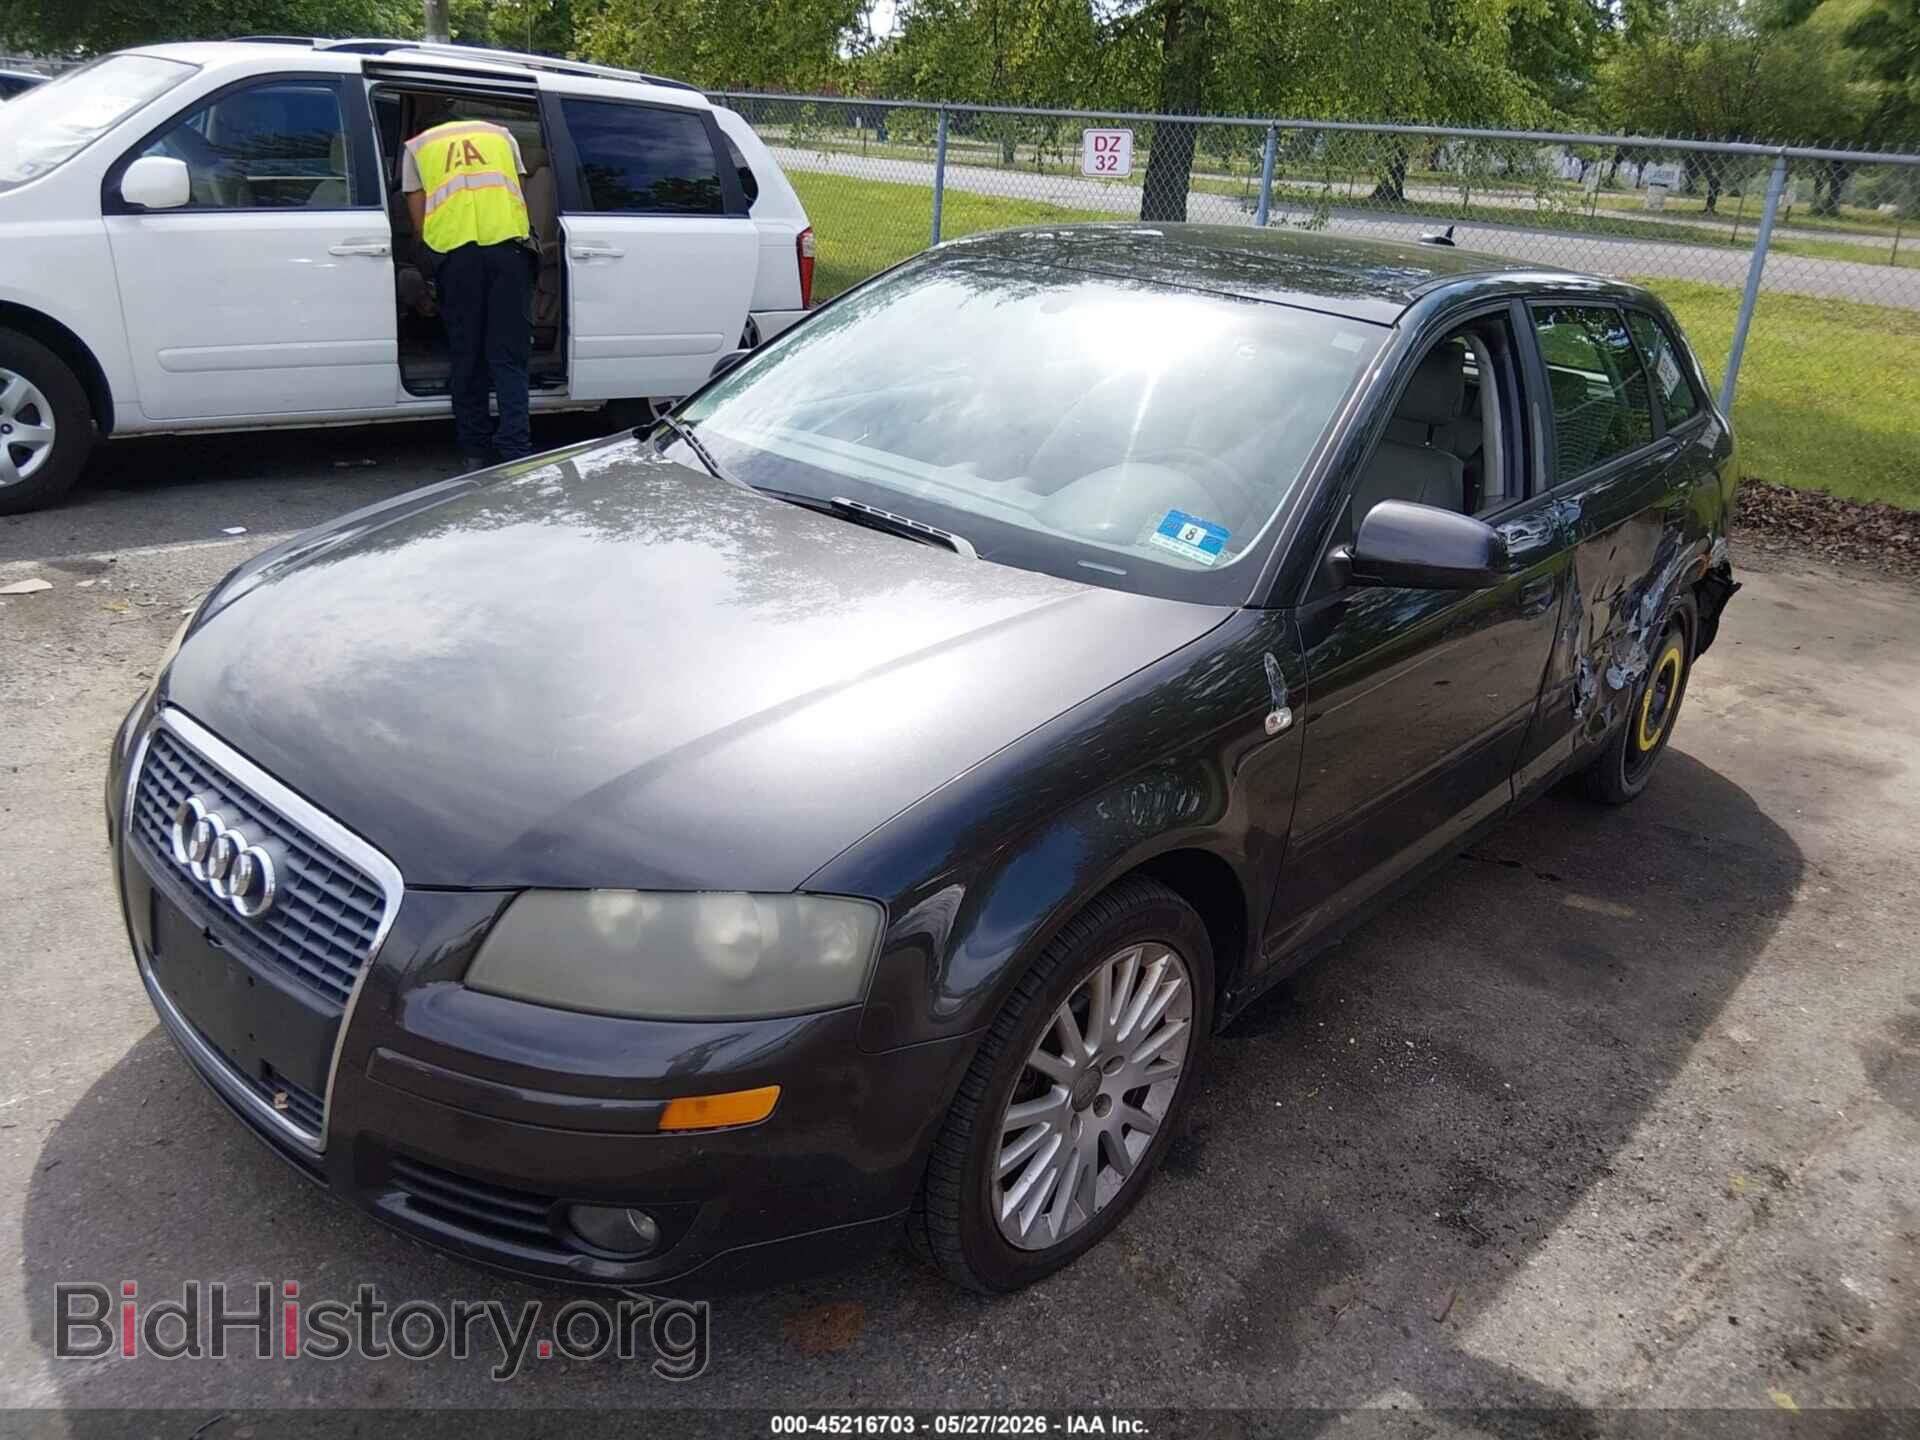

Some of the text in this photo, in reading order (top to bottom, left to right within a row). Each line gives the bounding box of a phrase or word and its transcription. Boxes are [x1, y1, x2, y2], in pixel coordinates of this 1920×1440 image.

[1094, 136, 1121, 152] DZ
[1095, 155, 1118, 171] 32
[1185, 527, 1198, 541] 8
